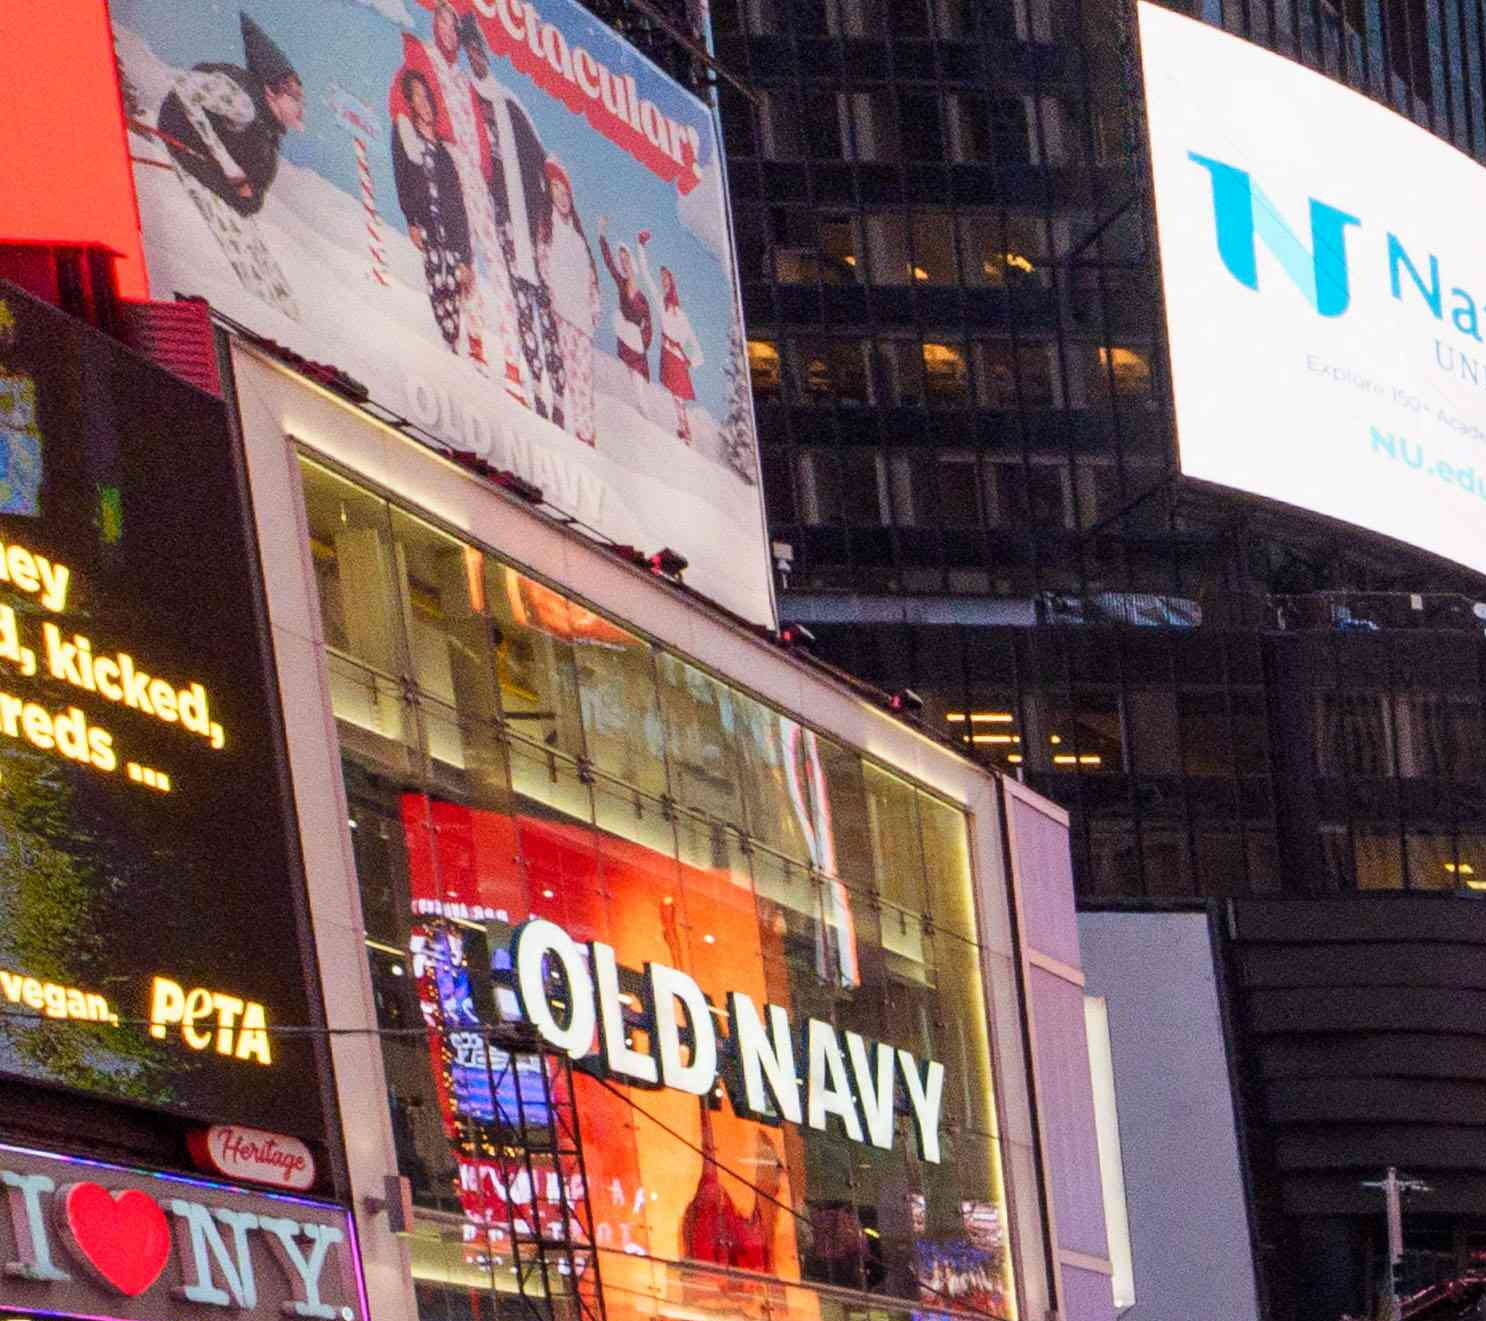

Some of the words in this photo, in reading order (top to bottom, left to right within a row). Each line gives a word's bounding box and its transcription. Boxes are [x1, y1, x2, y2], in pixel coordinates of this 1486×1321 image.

[43, 621, 227, 750] kicked,
[516, 919, 716, 1096] OLD
[729, 992, 945, 1163] NAVY
[217, 1127, 308, 1179] Heritage
[172, 1202, 345, 1321] NY
